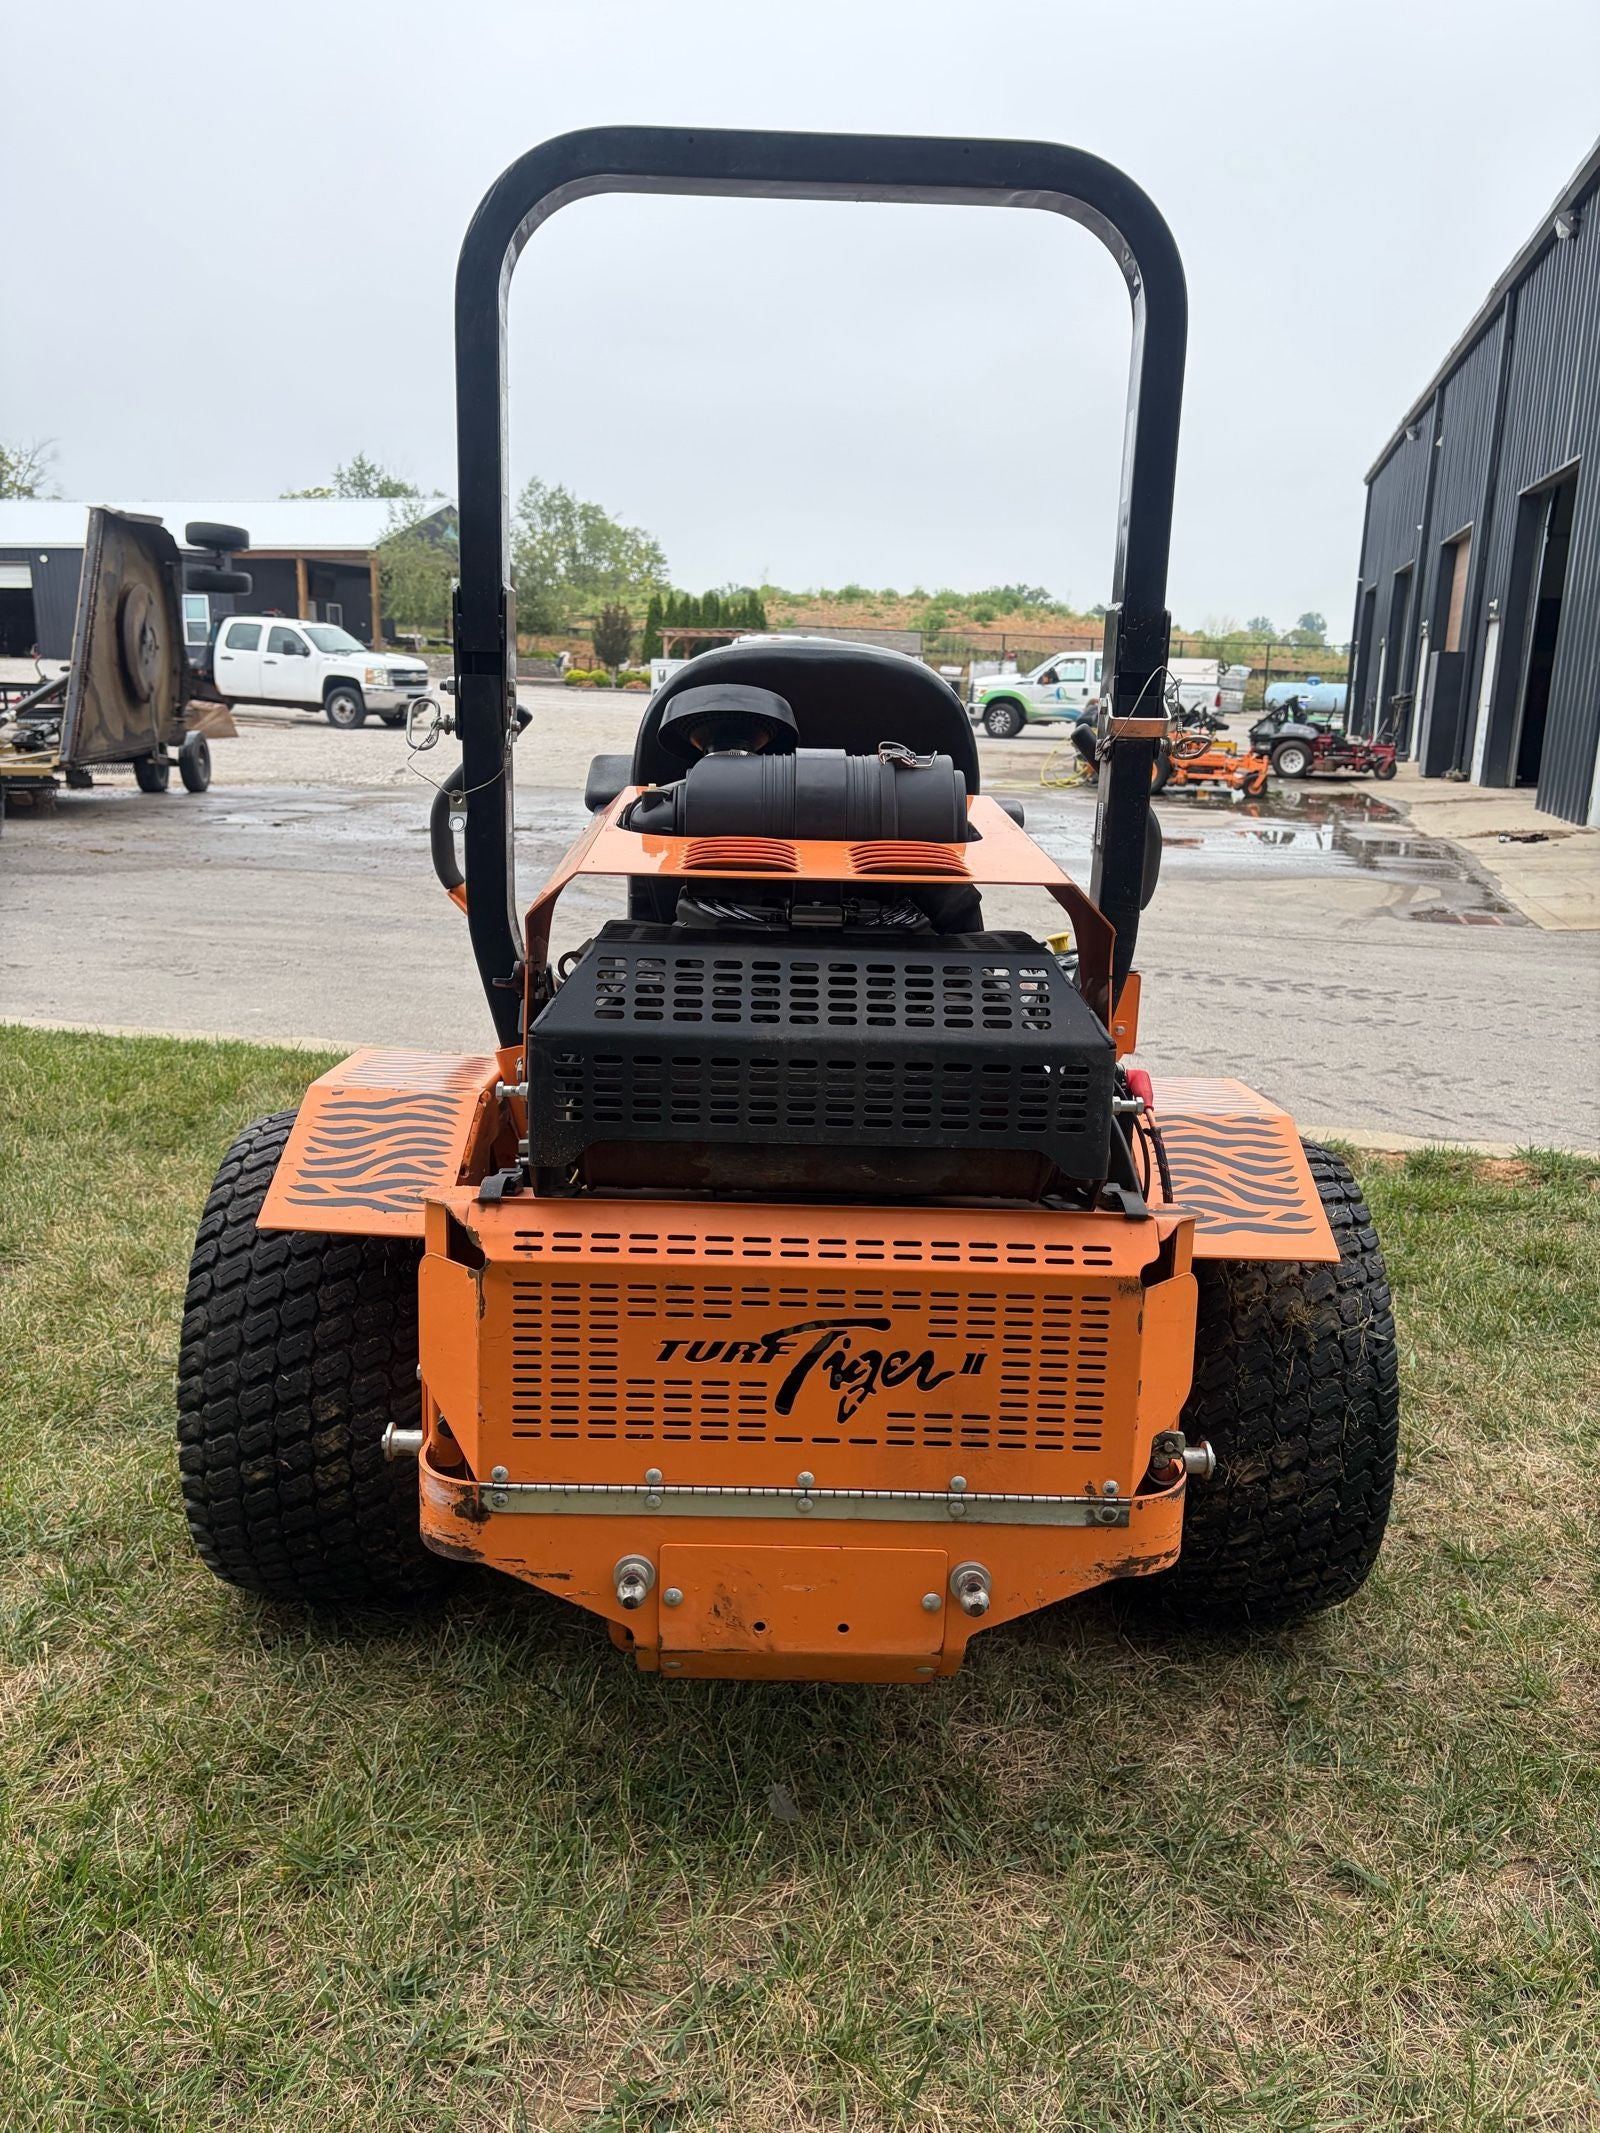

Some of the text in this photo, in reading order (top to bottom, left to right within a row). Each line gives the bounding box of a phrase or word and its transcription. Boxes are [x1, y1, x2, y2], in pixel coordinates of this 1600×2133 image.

[656, 1317, 989, 1424] TURF Tiger II
